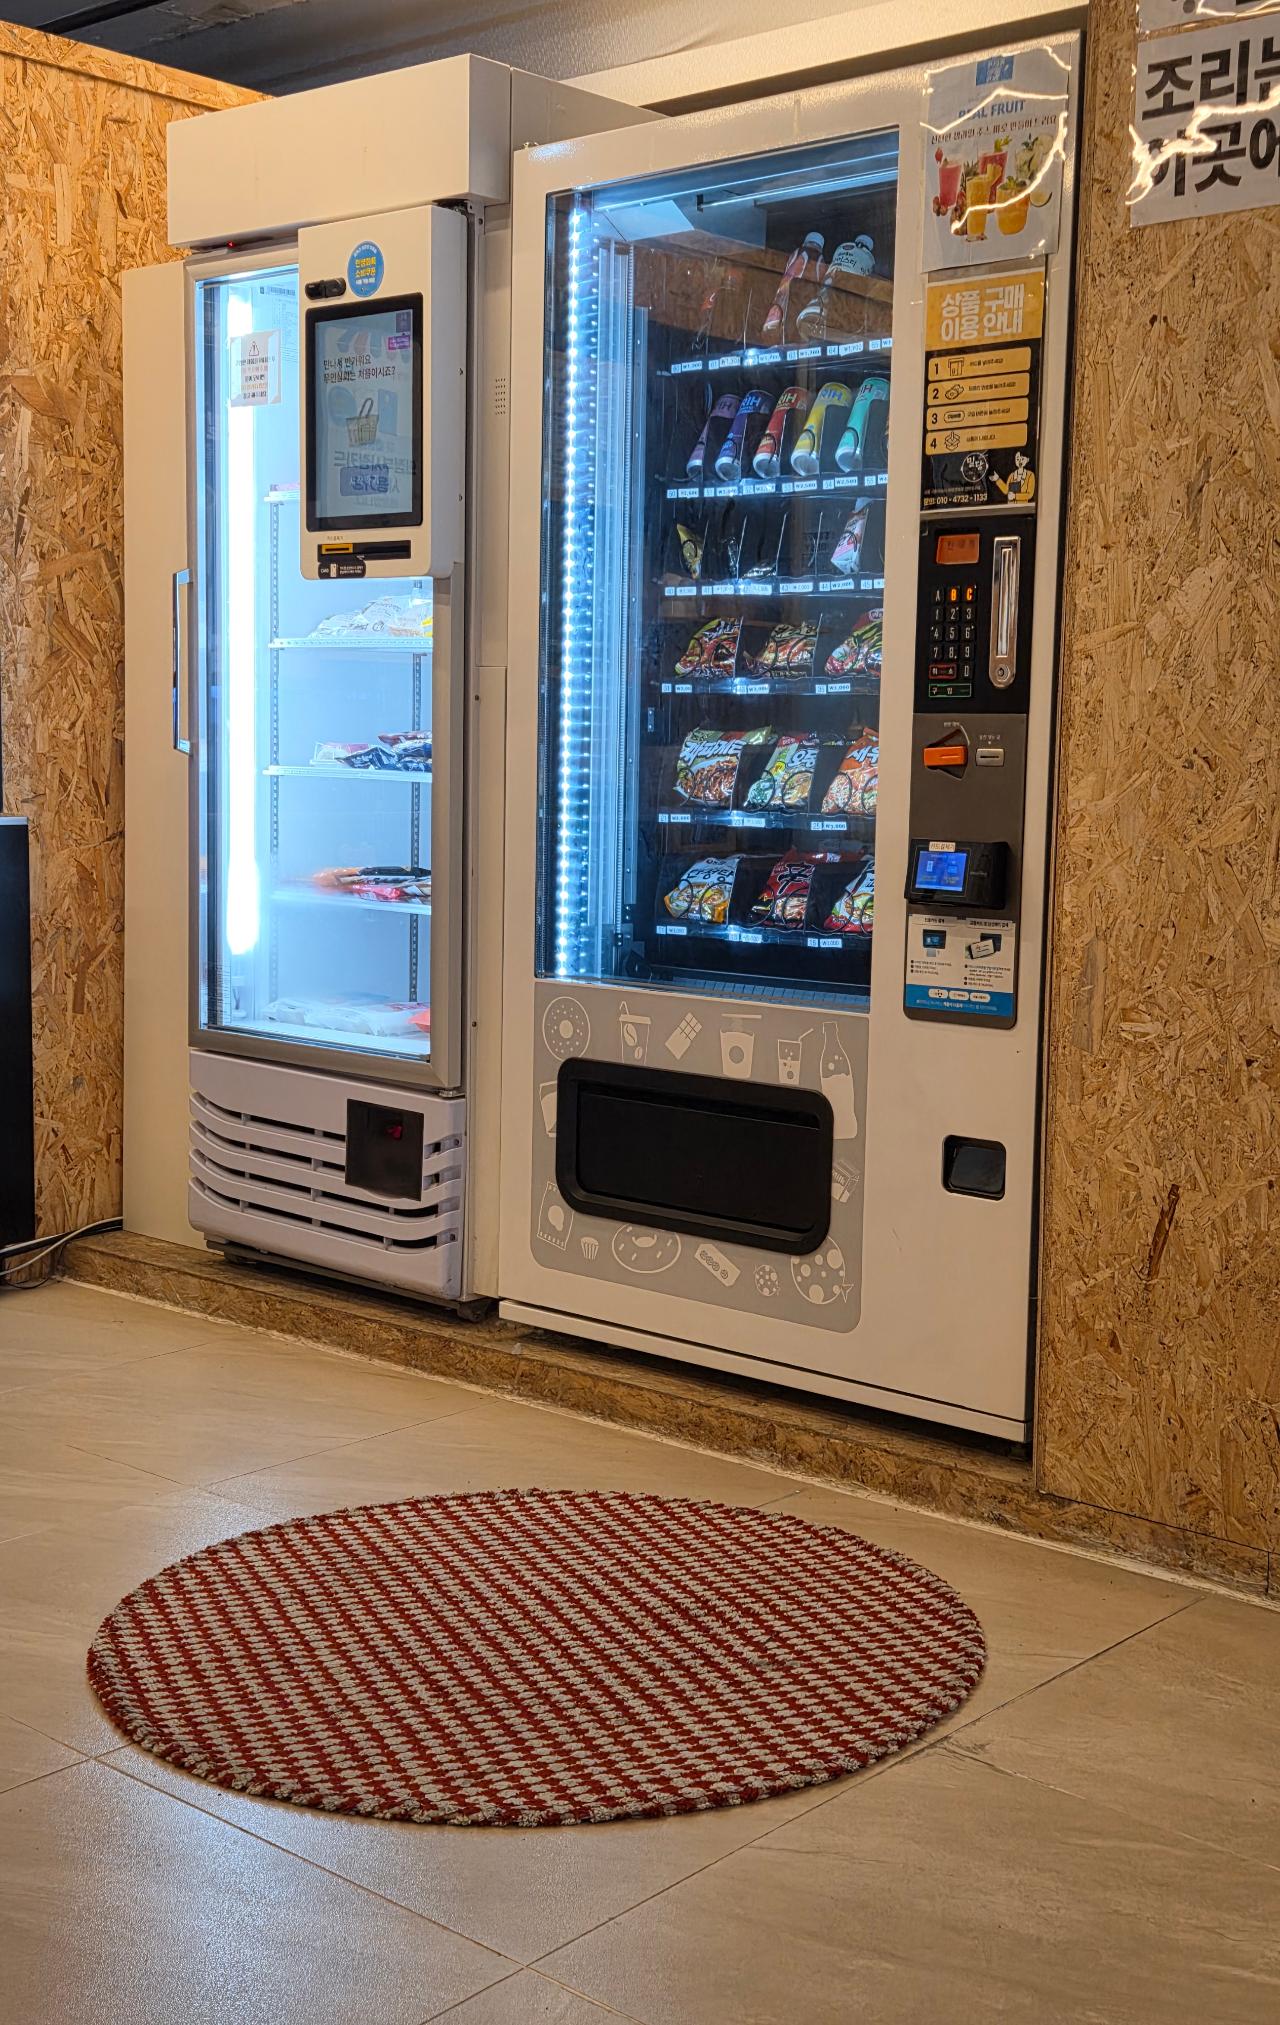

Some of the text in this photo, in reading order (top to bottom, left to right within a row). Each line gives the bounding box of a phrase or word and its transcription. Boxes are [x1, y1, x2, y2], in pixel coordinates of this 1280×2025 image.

[990, 99, 1025, 116] FRUIT
[942, 283, 1025, 318] 상품 구매
[941, 309, 1023, 341] 이용 안내
[934, 363, 939, 375] 1
[932, 388, 940, 400] 2
[931, 413, 938, 425] 3
[930, 438, 937, 450] 4
[935, 587, 973, 602] A B C
[950, 608, 956, 620] 2
[966, 608, 972, 620] 3
[933, 628, 971, 640] 4 5 6
[933, 646, 970, 658] 7 8 9
